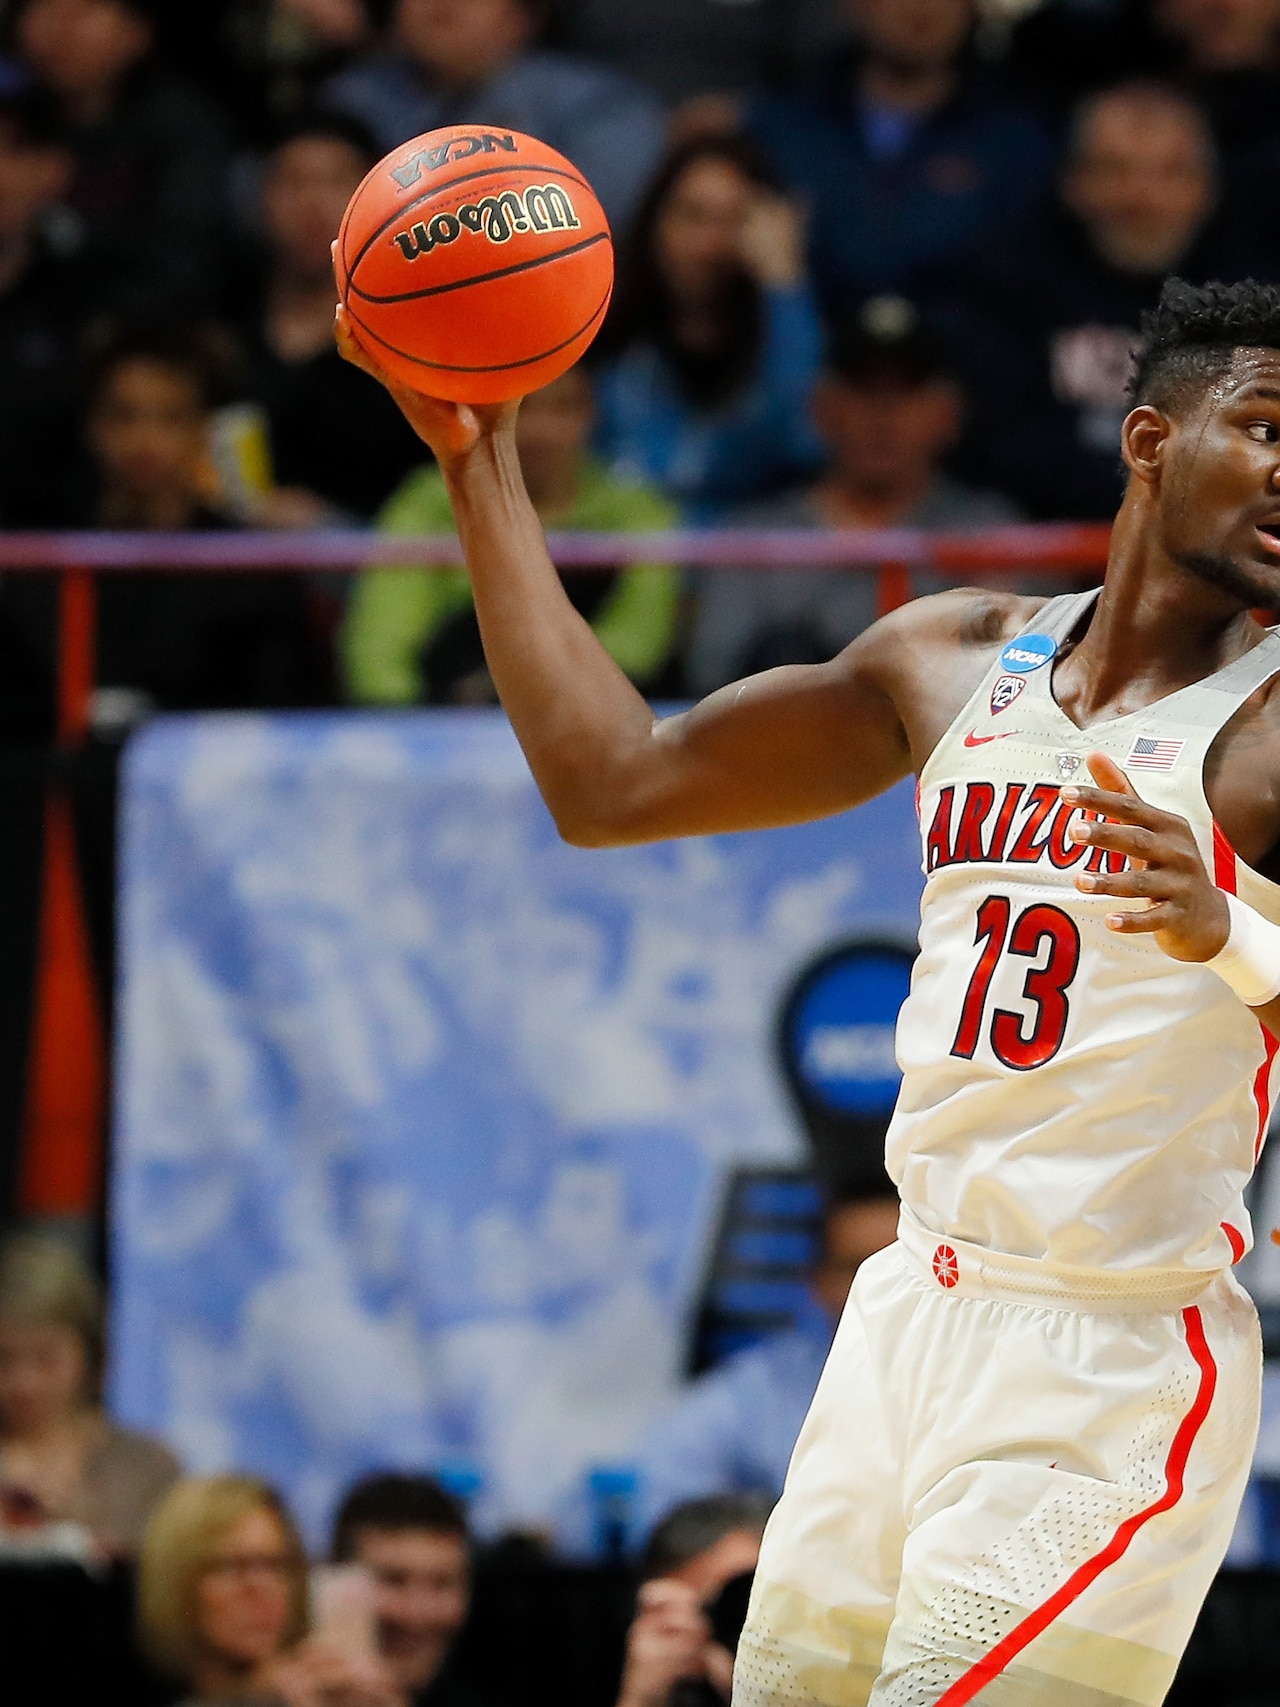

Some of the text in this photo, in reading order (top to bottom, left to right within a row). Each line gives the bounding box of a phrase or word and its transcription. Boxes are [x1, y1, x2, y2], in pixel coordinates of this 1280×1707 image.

[390, 134, 518, 189] NCAA
[394, 183, 582, 263] Wilson
[1003, 648, 1047, 665] NCAA
[992, 691, 1011, 707] 12
[994, 677, 1025, 700] PAC
[950, 895, 1081, 1071] 13
